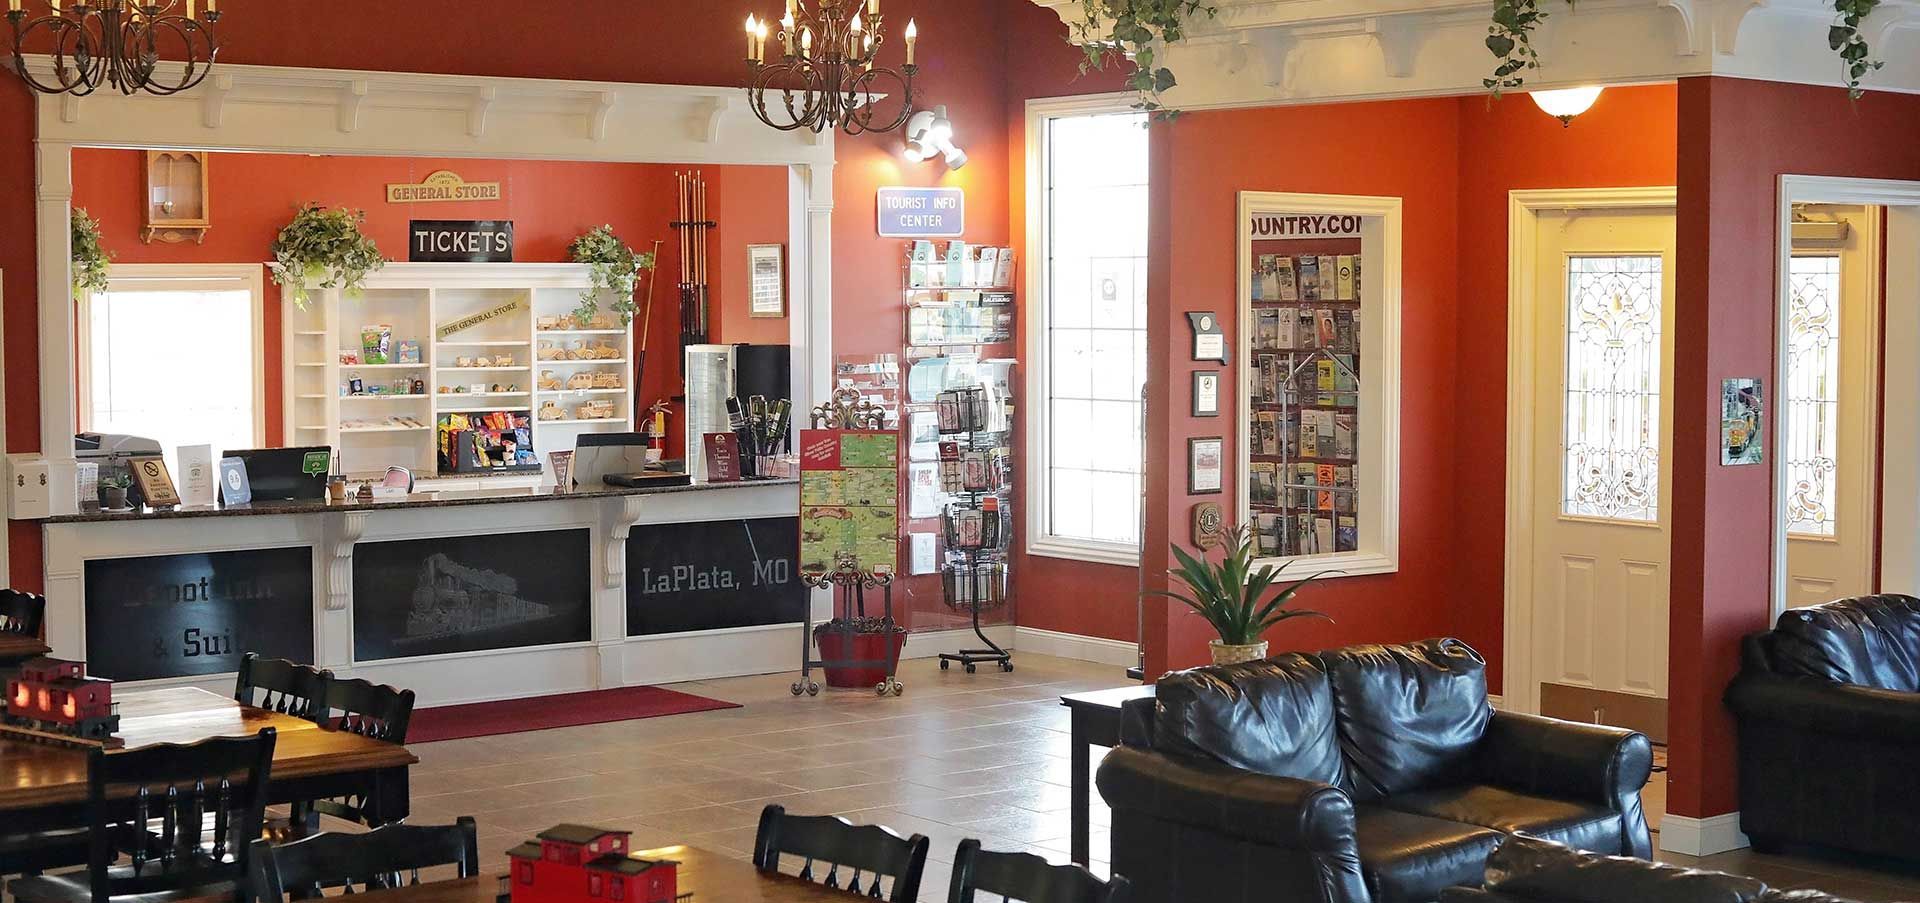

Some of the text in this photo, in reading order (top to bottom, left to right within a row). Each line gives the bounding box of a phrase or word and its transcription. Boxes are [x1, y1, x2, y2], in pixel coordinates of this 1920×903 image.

[393, 185, 497, 200] GENERAL STORE
[886, 196, 956, 209] TOURIST INFO
[900, 214, 942, 227] CENTER
[415, 230, 507, 252] TICKETS
[443, 302, 518, 335] THE GENERAL STORE
[642, 558, 789, 594] LaPlata, MO
[121, 576, 210, 608] pot
